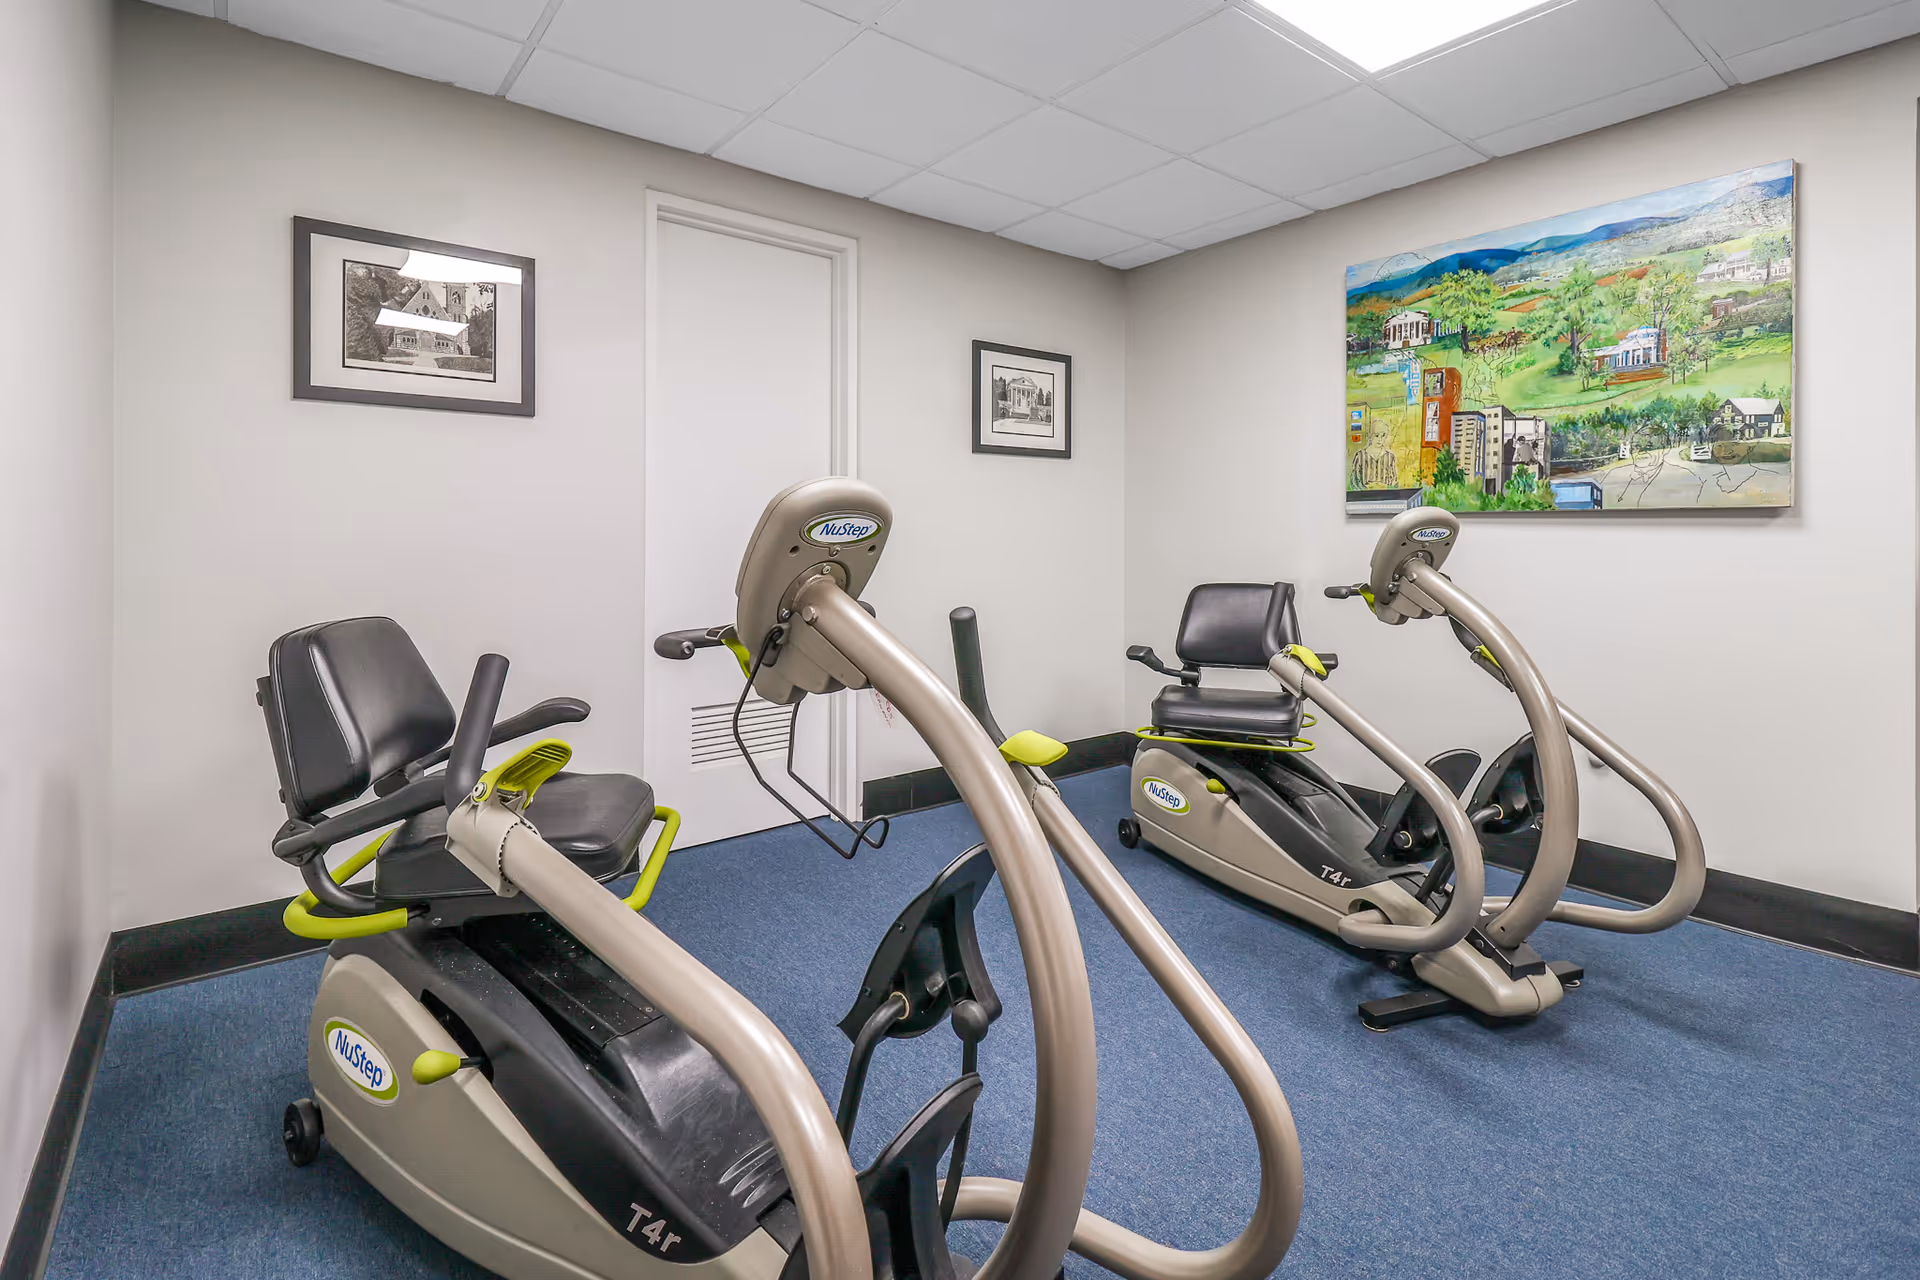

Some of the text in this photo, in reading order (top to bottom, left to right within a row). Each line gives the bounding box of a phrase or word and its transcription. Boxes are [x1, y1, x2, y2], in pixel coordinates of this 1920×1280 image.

[819, 522, 870, 538] NuStep
[1416, 529, 1446, 539] NuStep
[1148, 782, 1180, 808] NuStep
[1320, 864, 1352, 887] T4r
[335, 1029, 383, 1088] NuStep
[626, 1202, 682, 1253] T4r
